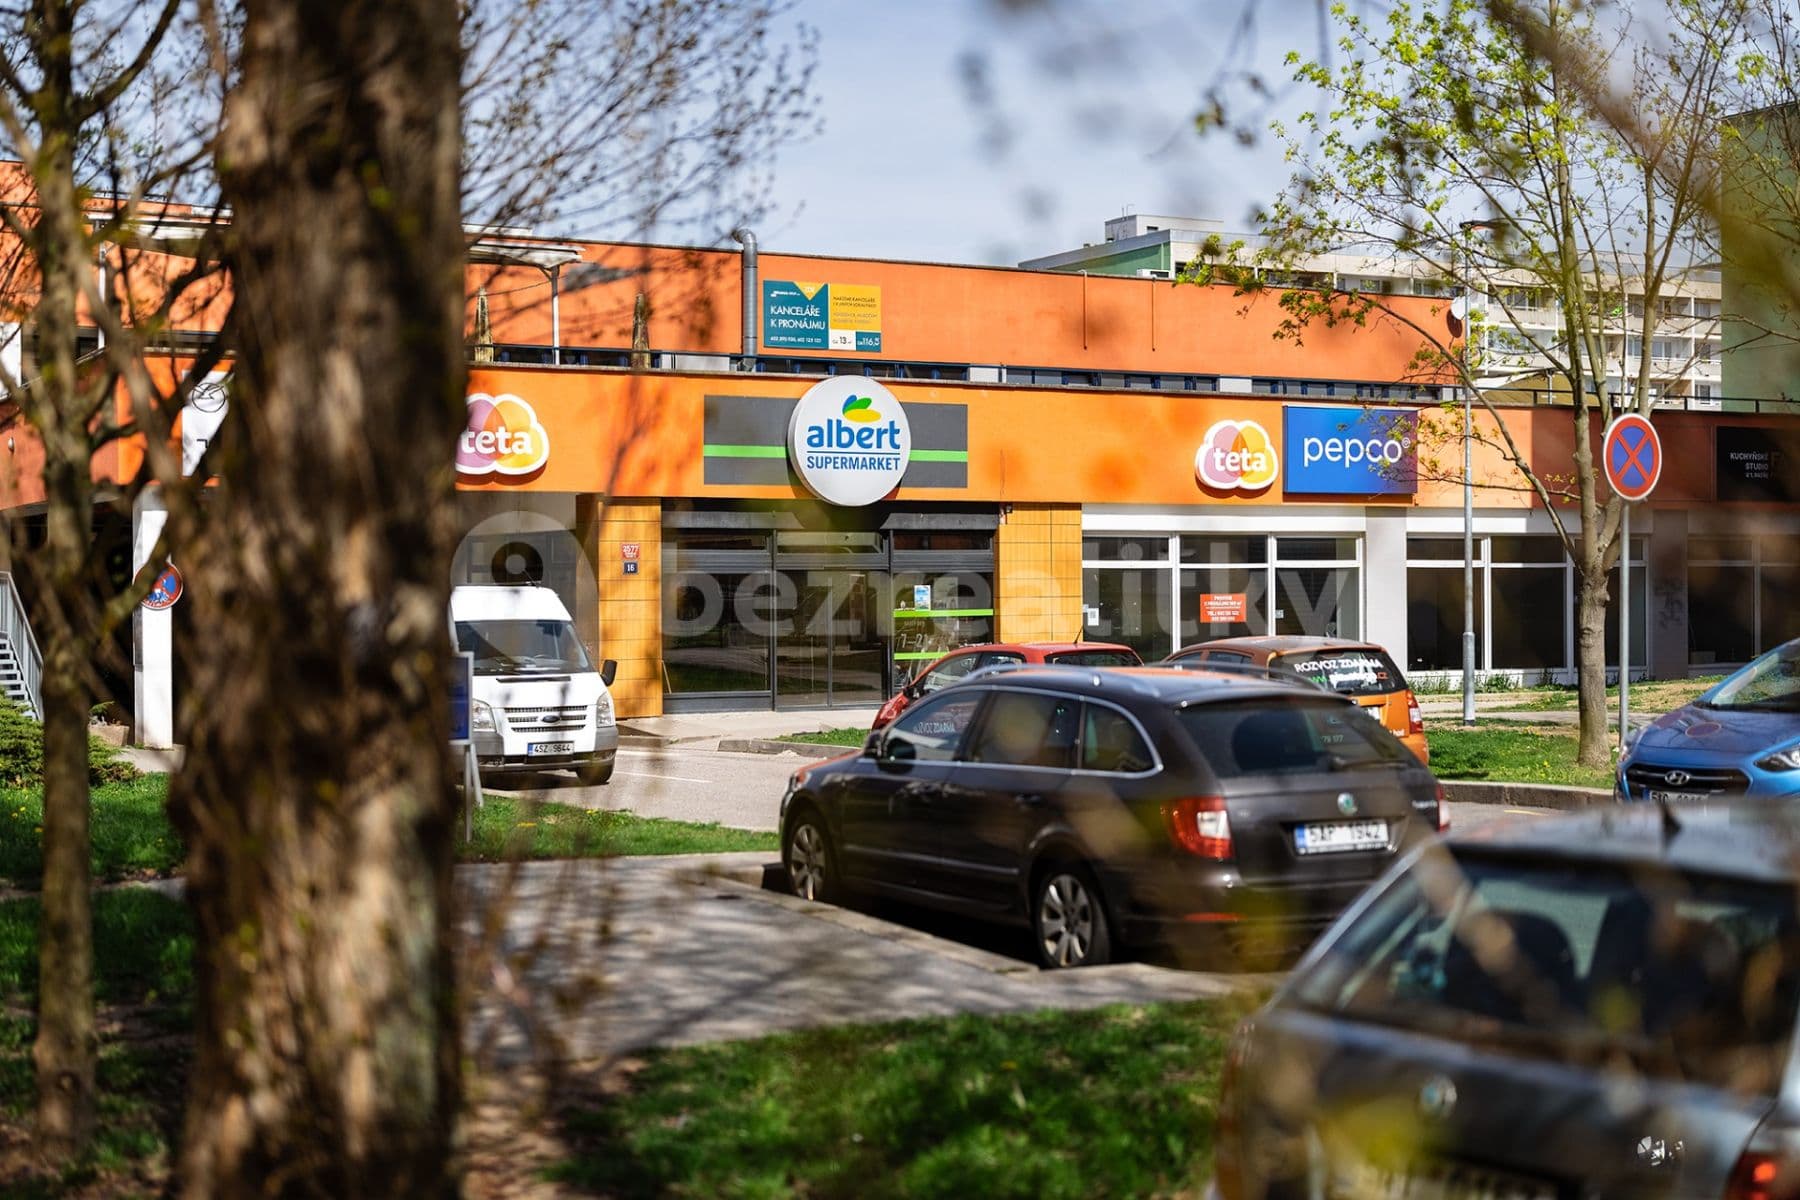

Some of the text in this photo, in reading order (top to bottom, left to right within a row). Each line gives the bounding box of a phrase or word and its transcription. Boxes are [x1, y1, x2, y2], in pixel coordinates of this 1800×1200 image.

[770, 304, 821, 317] KANCELÁŘE
[770, 318, 777, 328] K
[778, 317, 826, 330] PRONÁJMU
[806, 418, 901, 450] albert
[806, 454, 901, 472] SUPERMARKET
[1213, 447, 1267, 472] teta
[627, 563, 635, 572] 16
[1293, 657, 1384, 674] ROZVOZ ZDARMA
